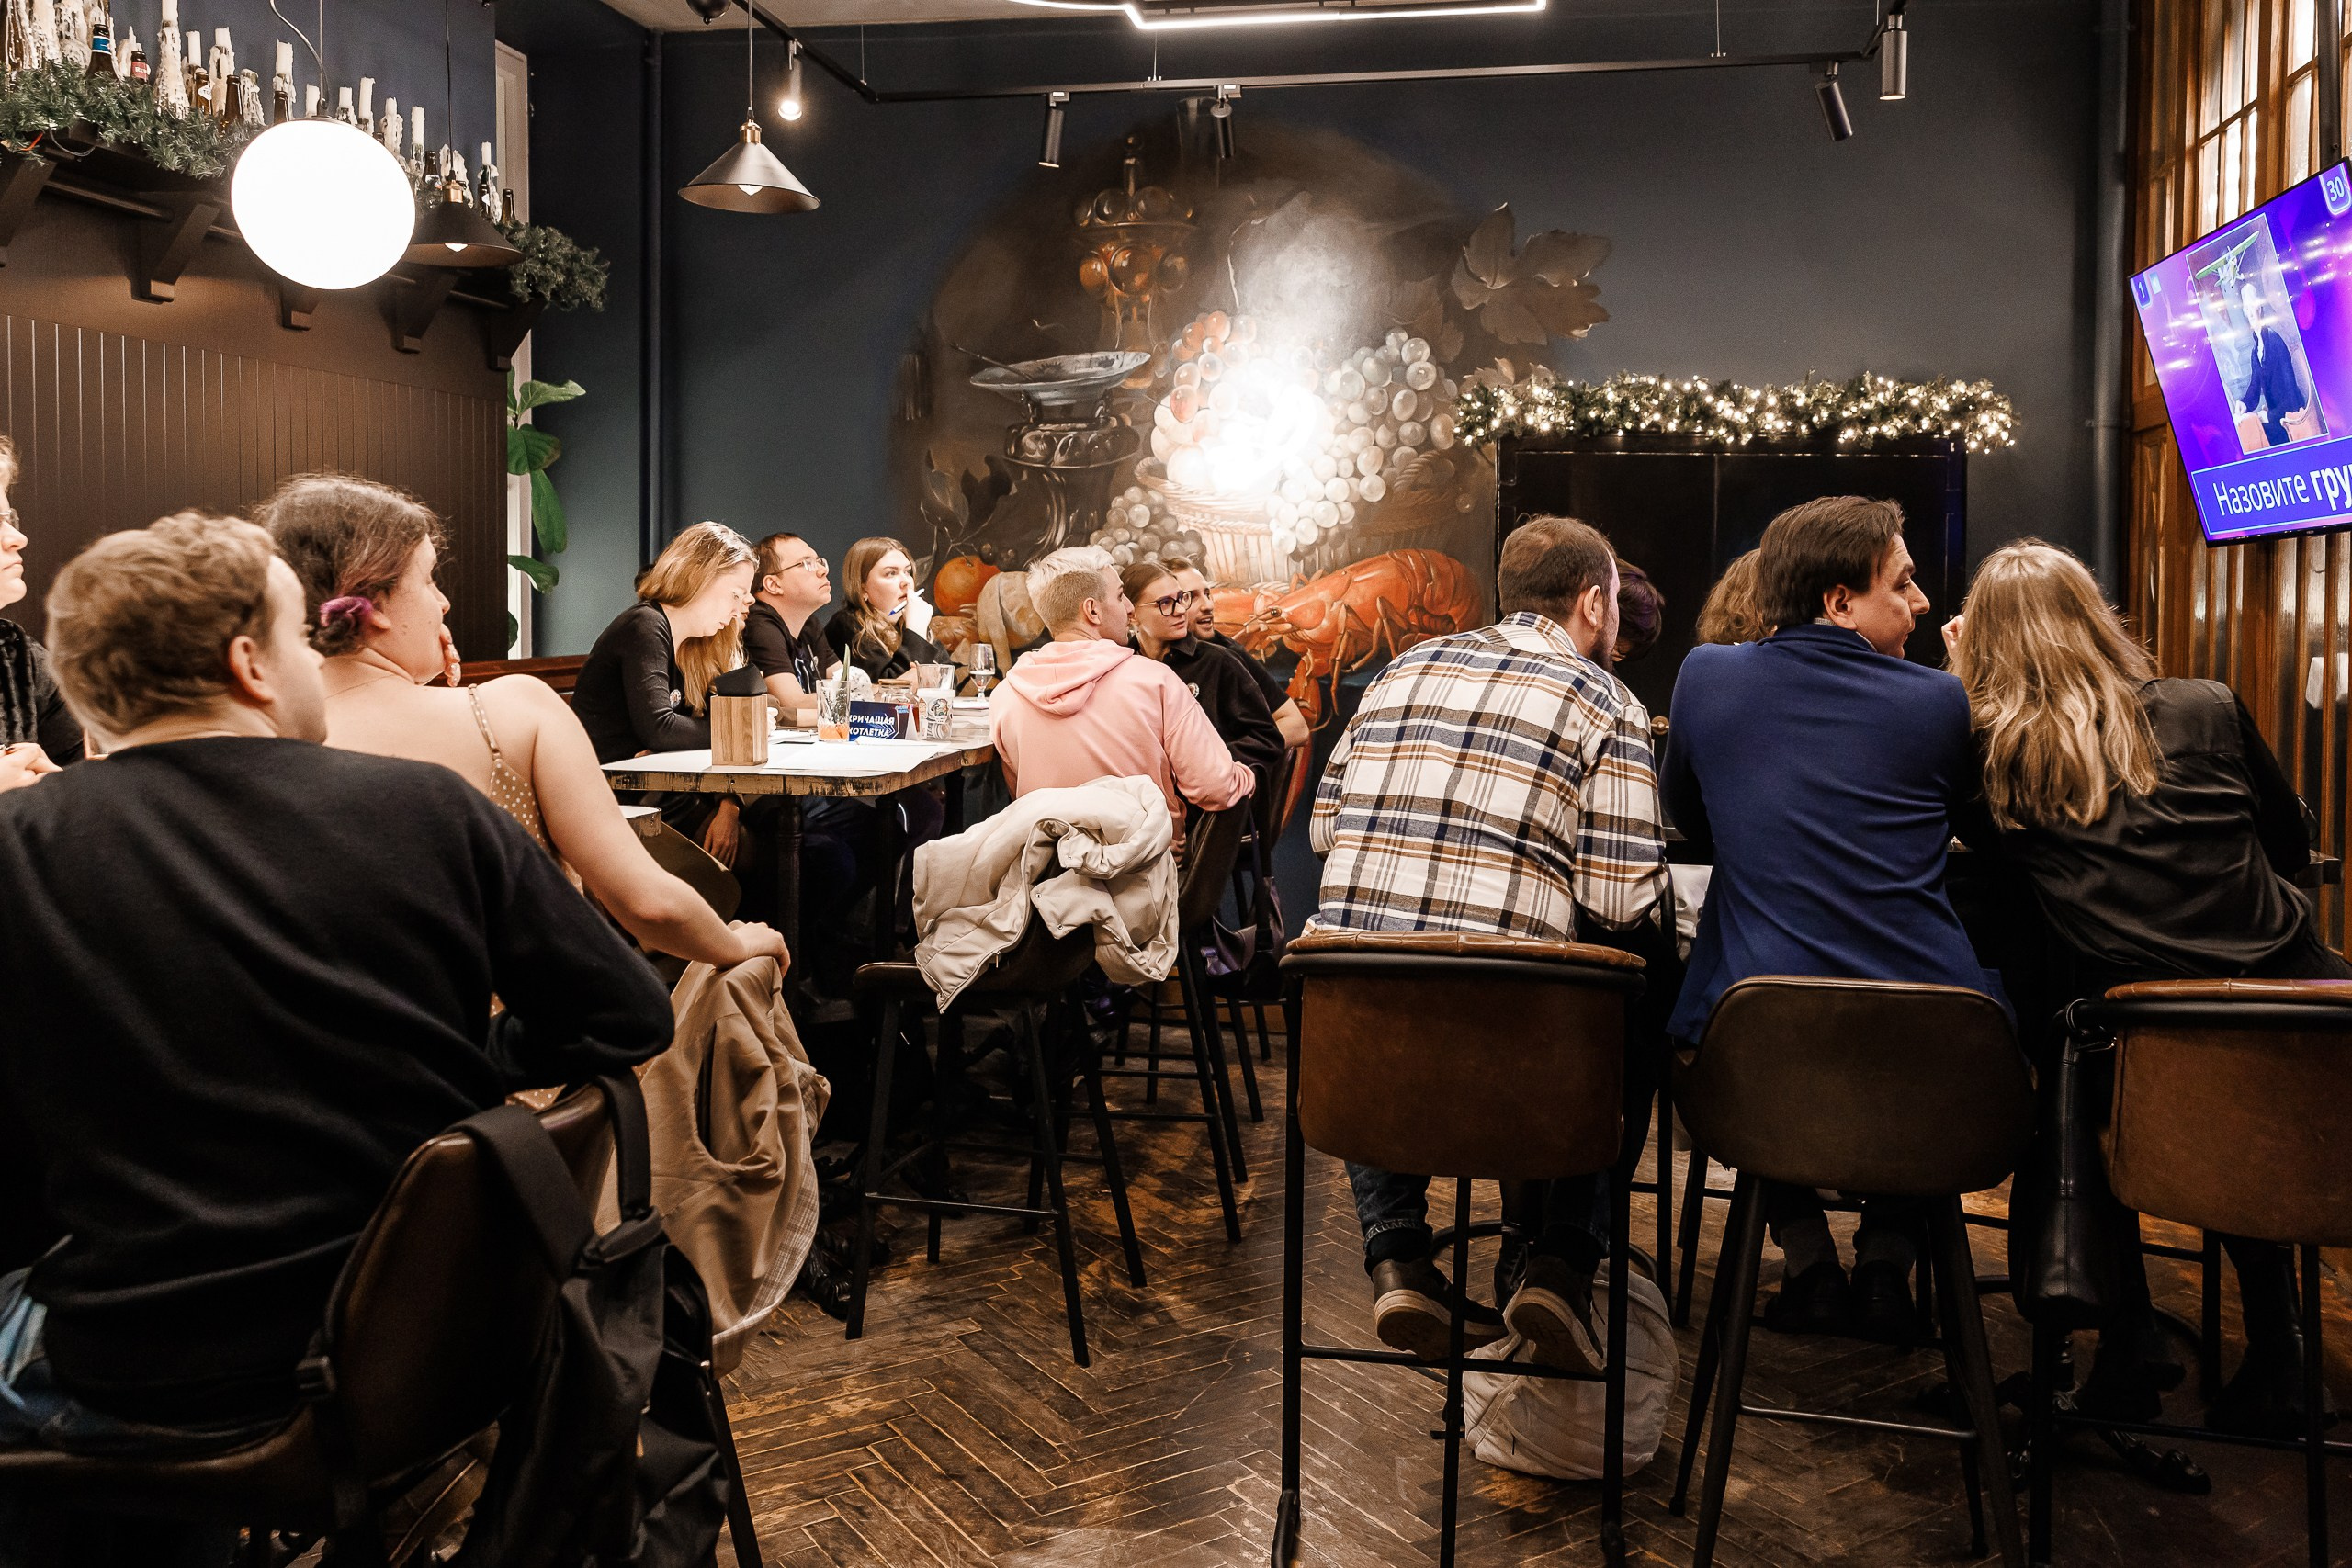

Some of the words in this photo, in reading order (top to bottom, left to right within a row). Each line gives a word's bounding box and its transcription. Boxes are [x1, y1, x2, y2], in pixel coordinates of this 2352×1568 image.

[2326, 176, 2345, 202] 30
[2138, 281, 2145, 299] 1
[2212, 474, 2310, 516] Назовите
[2309, 463, 2352, 512] гру
